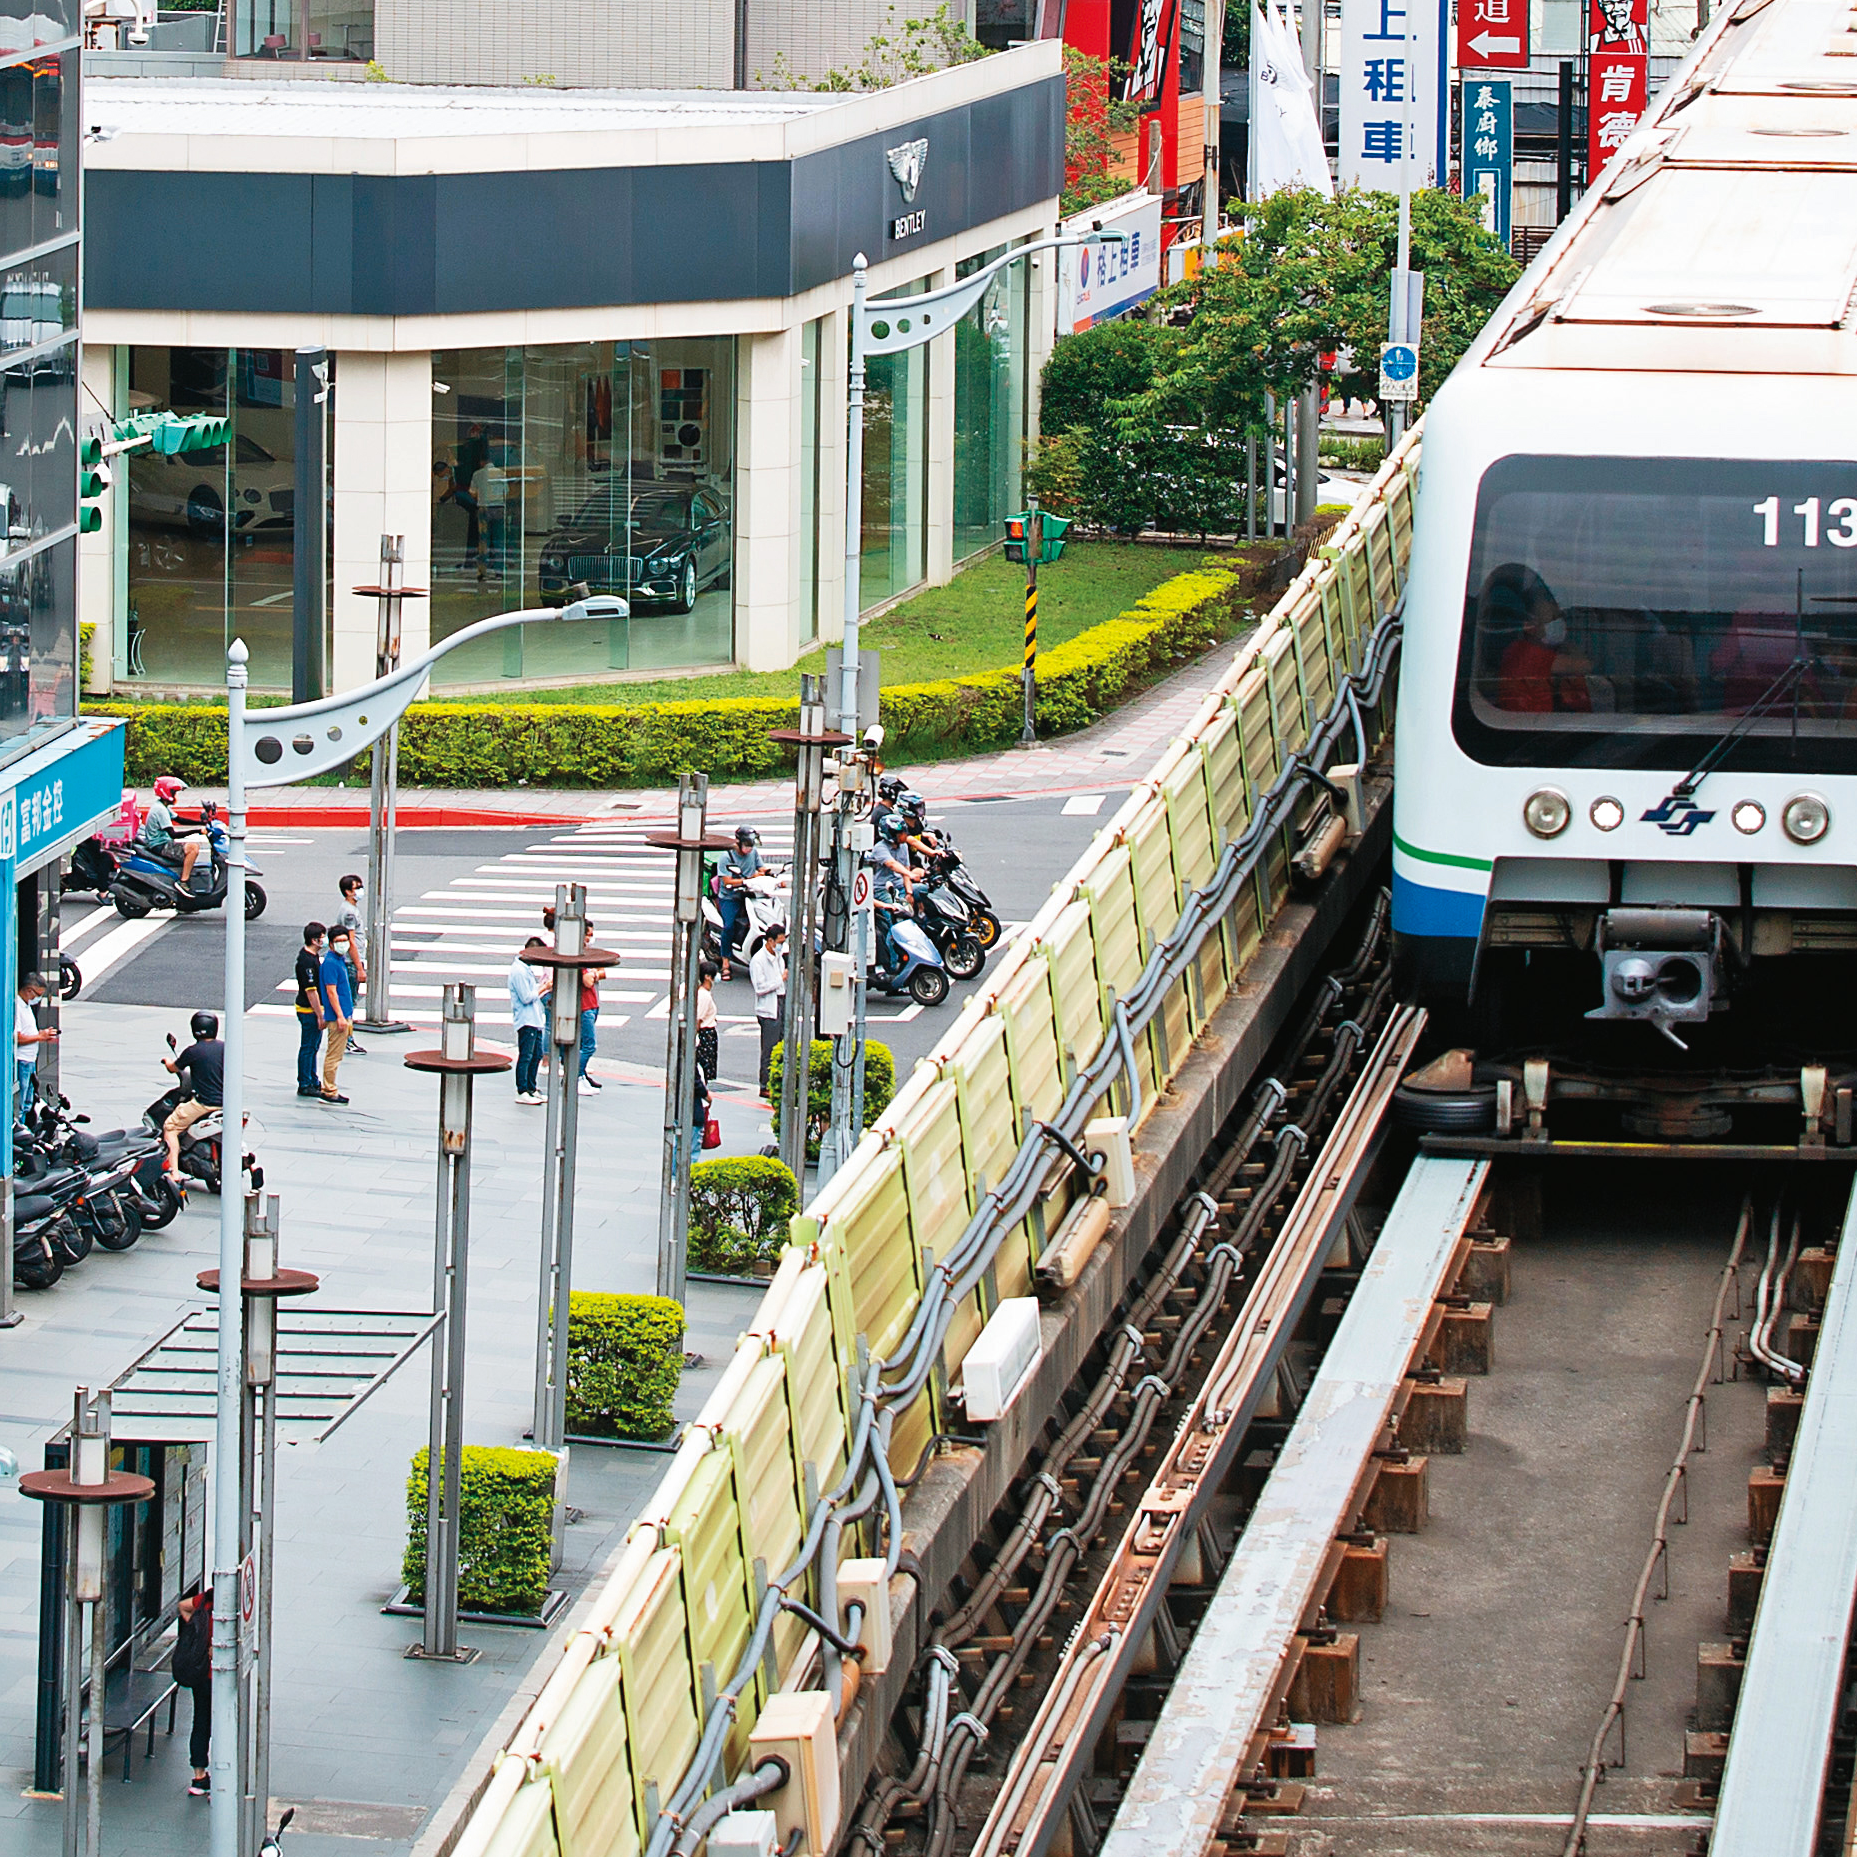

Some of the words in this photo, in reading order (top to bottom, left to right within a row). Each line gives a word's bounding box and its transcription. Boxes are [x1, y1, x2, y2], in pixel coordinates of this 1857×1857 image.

[1597, 64, 1638, 164] 肯德
[894, 209, 927, 240] BENTLEY
[20, 778, 63, 846] 富邦金控
